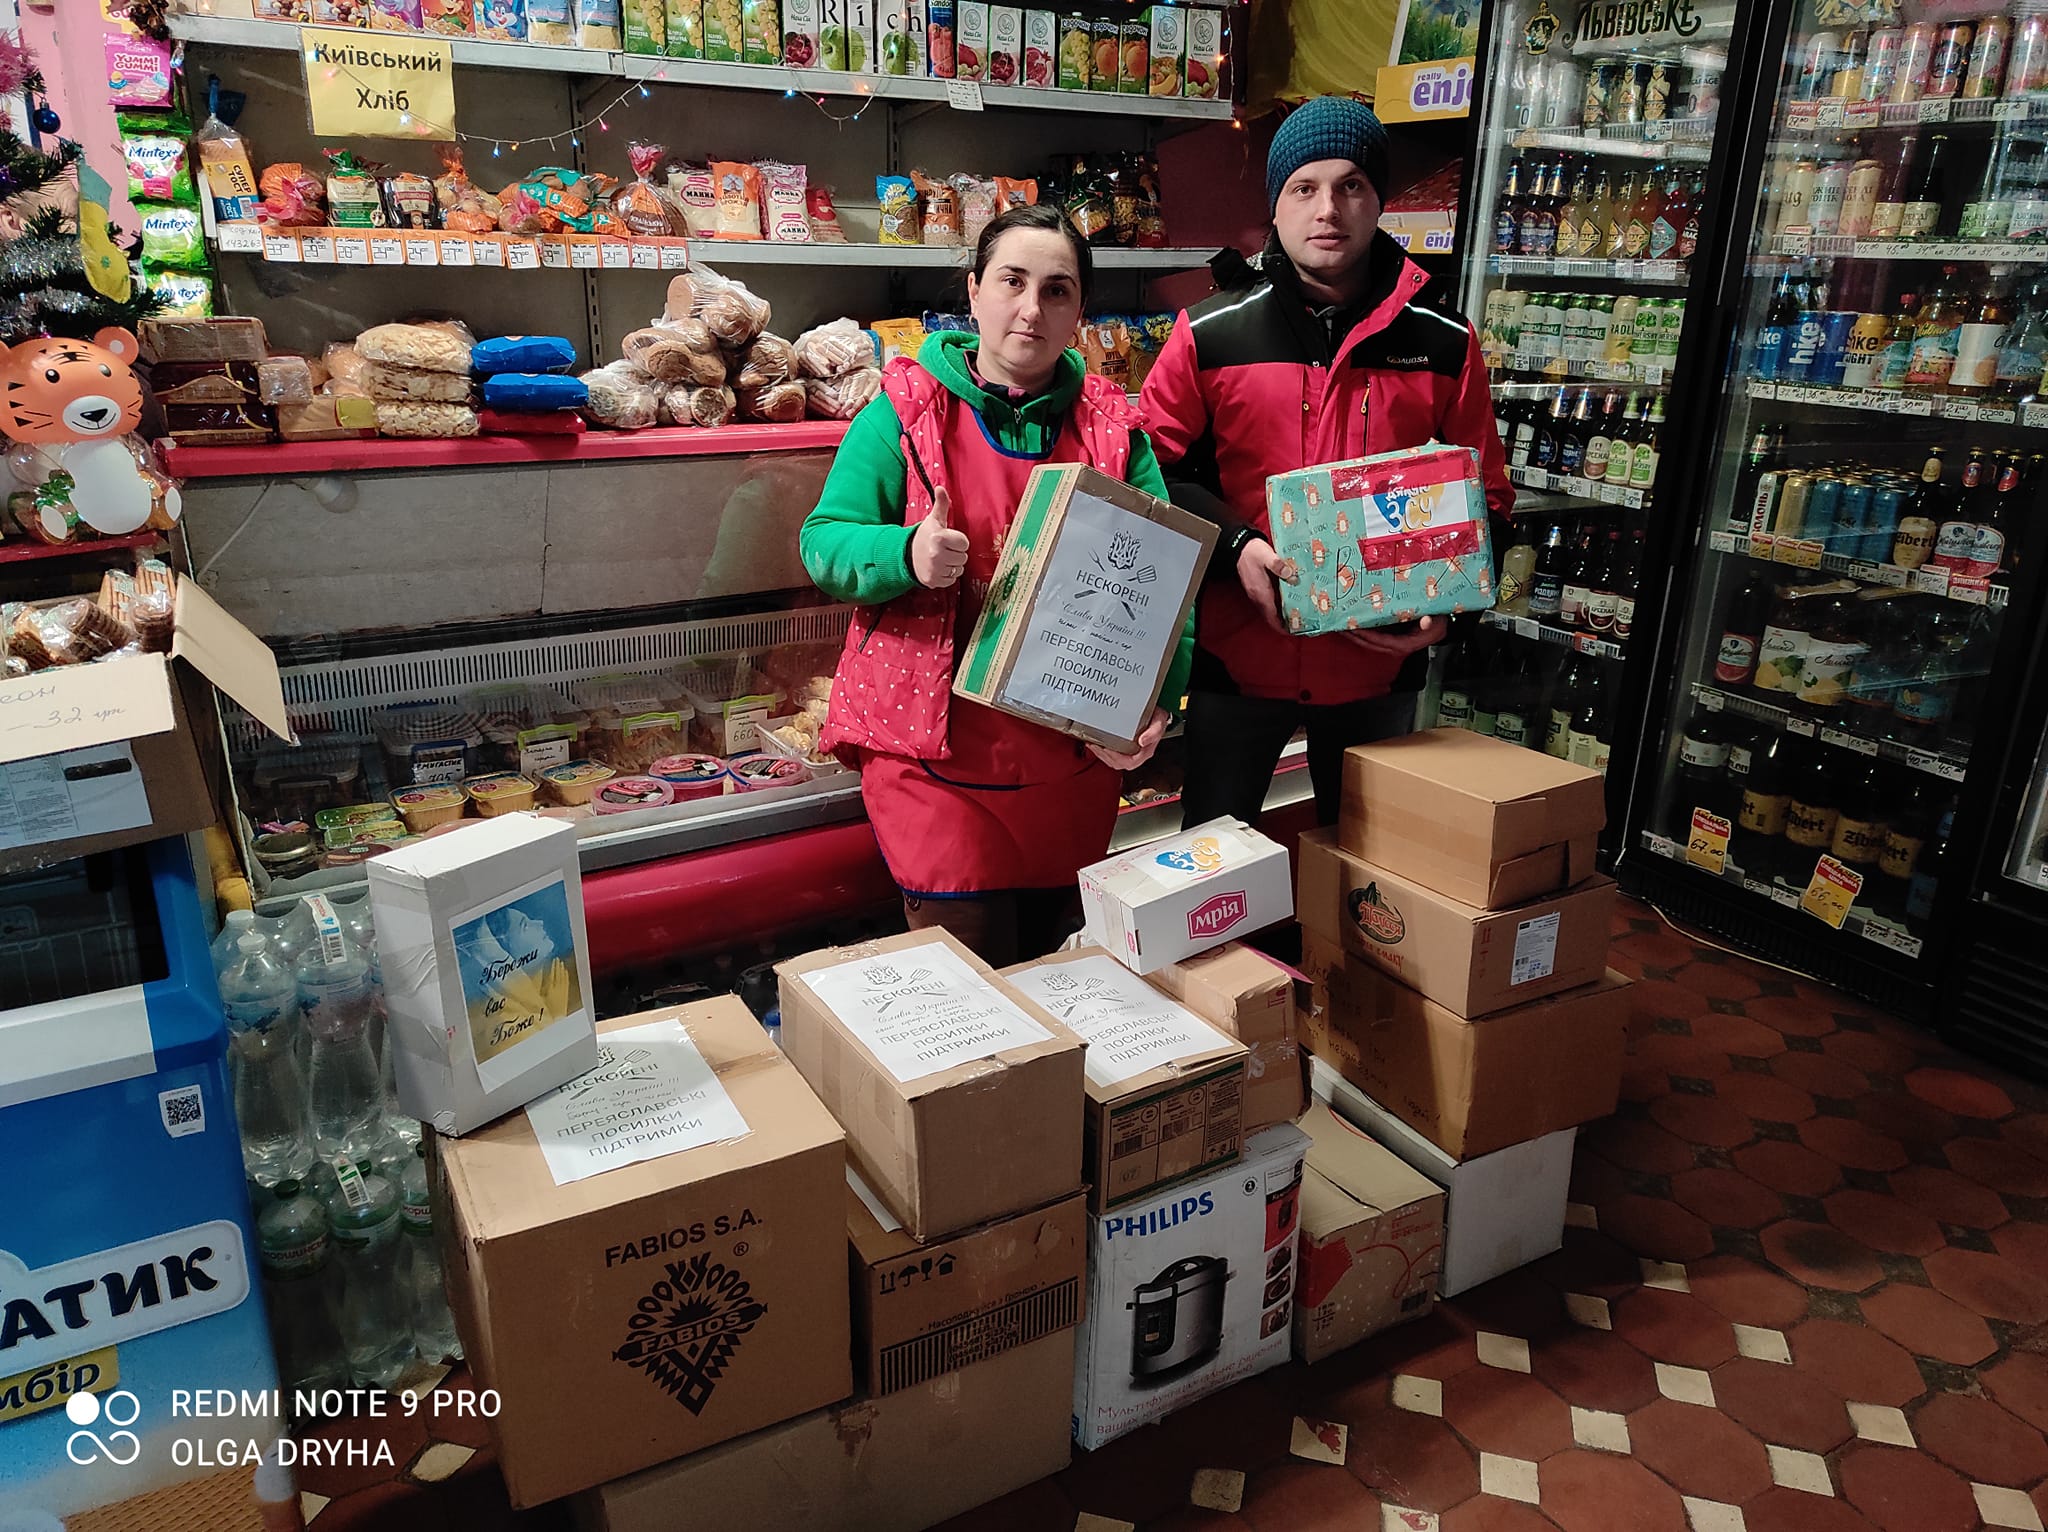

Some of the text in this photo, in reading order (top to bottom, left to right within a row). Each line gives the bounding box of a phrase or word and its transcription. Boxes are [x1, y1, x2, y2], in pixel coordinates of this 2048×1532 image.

[314, 42, 441, 72] Київський
[1417, 72, 1441, 81] really
[355, 88, 409, 111] Хліб
[229, 172, 243, 193] ТОСТ
[232, 164, 252, 193] СУПЕР
[1788, 321, 1820, 365] hike
[1387, 496, 1435, 534] ЗСУ
[1076, 569, 1151, 608] НЕСКОРЕНІ
[1135, 628, 1148, 641] !!!
[1039, 629, 1145, 677] ПЕРЕЯСЛАВСЬКІ
[1053, 655, 1119, 688] ПОСИЛКИ
[1041, 672, 1121, 710] ПІДТРИМКИ
[480, 949, 539, 986] Бережи
[485, 997, 506, 1018] вас
[862, 980, 946, 1007] НЕСКОРЕНІ
[1046, 988, 1121, 1011] НЕСКОРЕНІ
[490, 1015, 535, 1046] Боже
[879, 1006, 1003, 1047] ПЕРЕЯСЛАВСЬКІ
[912, 1022, 989, 1049] ПОСИЛКИ
[1088, 1012, 1179, 1047] РЕЯСЛАВСЬКІ
[1101, 1026, 1170, 1052] ПОСИЛКИ
[916, 1027, 1012, 1062] ПІДТРИМКИ
[1108, 1032, 1192, 1064] ПІДТРИМКИ
[558, 1063, 659, 1094] НЕСКОРЕНІ
[556, 1090, 708, 1138] ПЕРЕЯСЛАВСЬКІ
[591, 1110, 683, 1144] ПОСИЛКИ
[588, 1118, 704, 1158] ПІДТРИМКИ
[1105, 1190, 1214, 1241] PHILIPS
[605, 1208, 763, 1268] FABIOS S.A.
[641, 1311, 742, 1354] FABIOS
